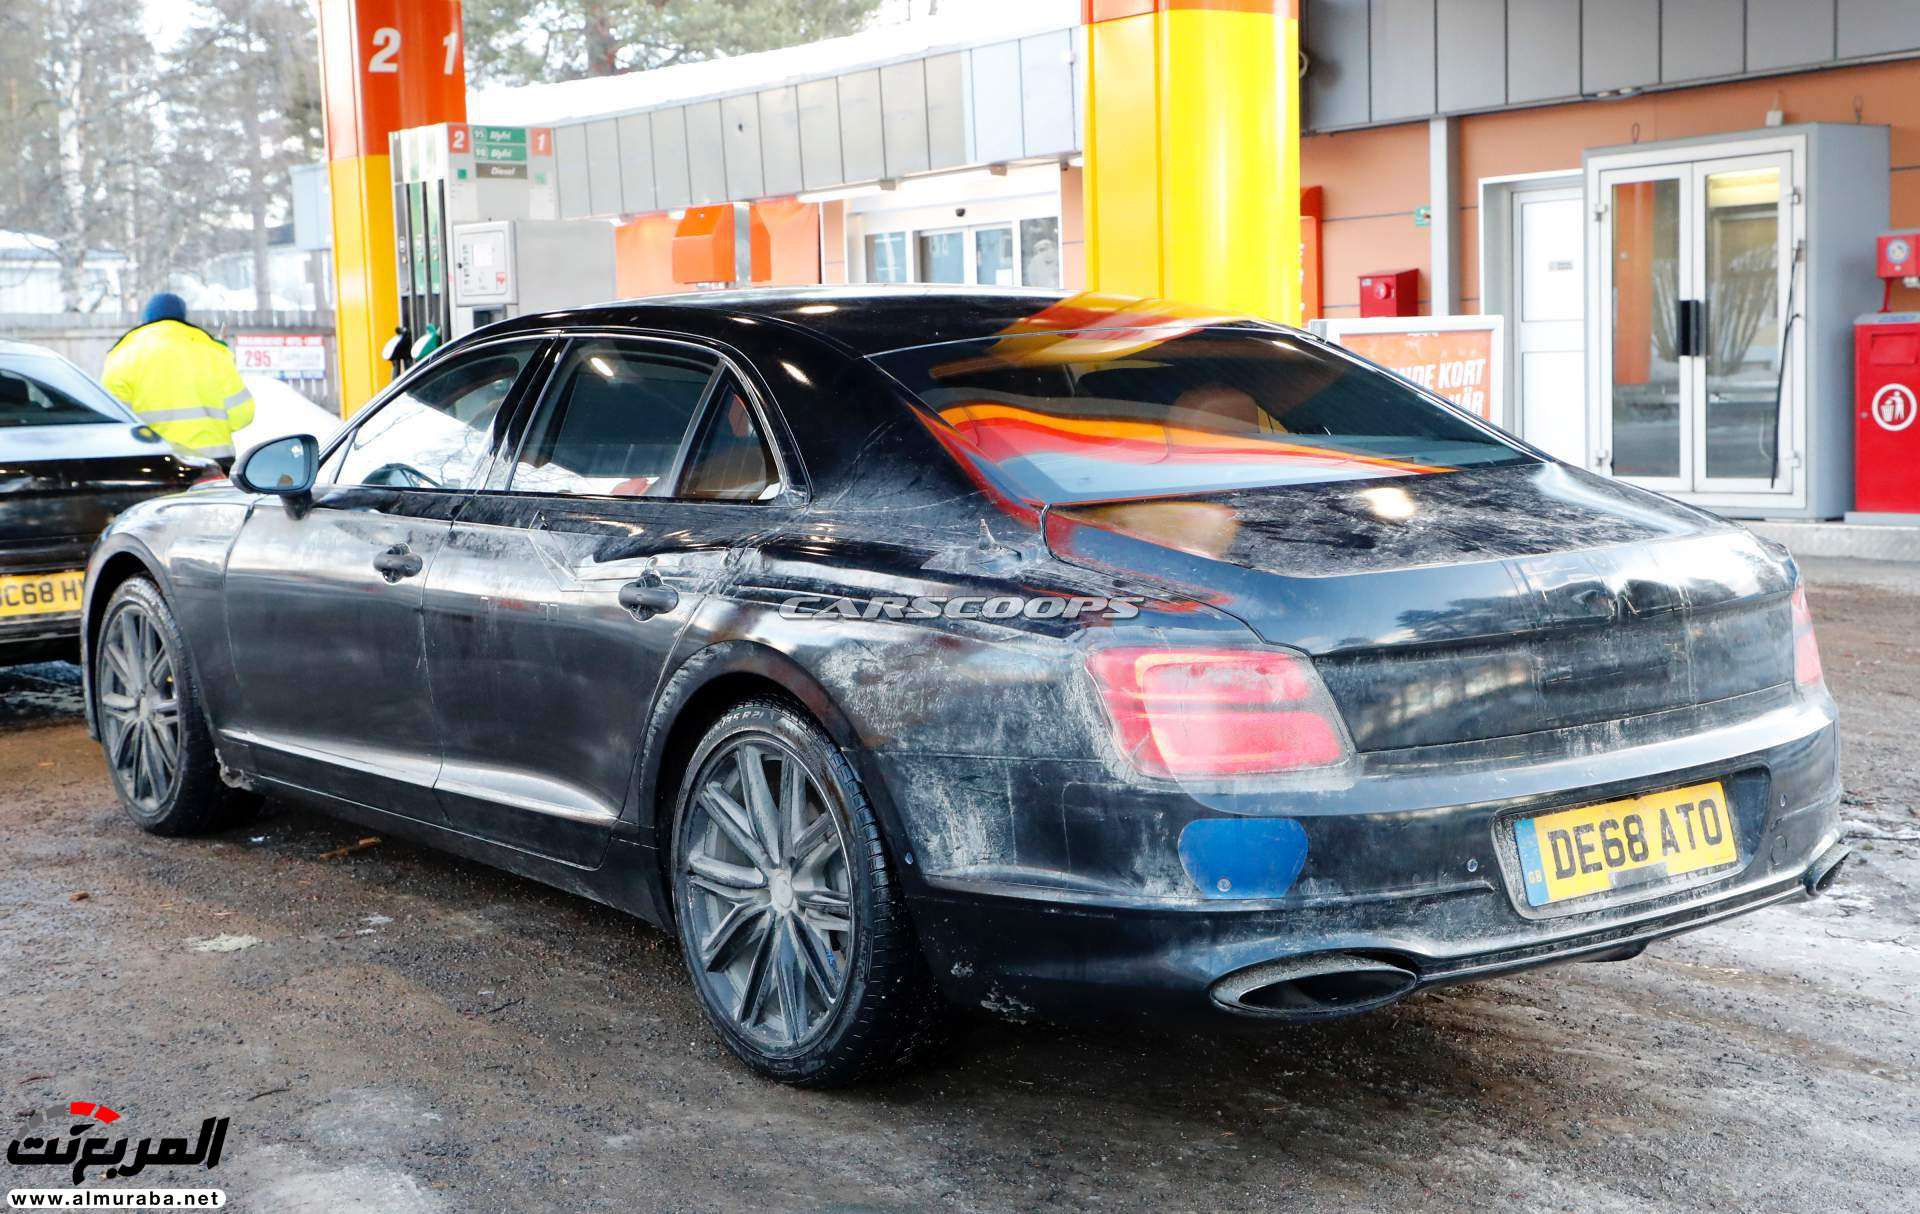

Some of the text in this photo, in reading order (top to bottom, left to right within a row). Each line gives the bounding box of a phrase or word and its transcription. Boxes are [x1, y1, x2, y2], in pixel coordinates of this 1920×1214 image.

[368, 27, 401, 73] 2
[442, 32, 457, 75] 1
[453, 130, 466, 149] 2
[537, 133, 546, 151] 1
[244, 350, 271, 368] 295
[1438, 358, 1487, 389] KORT
[1547, 798, 1723, 880] DE68 ATO
